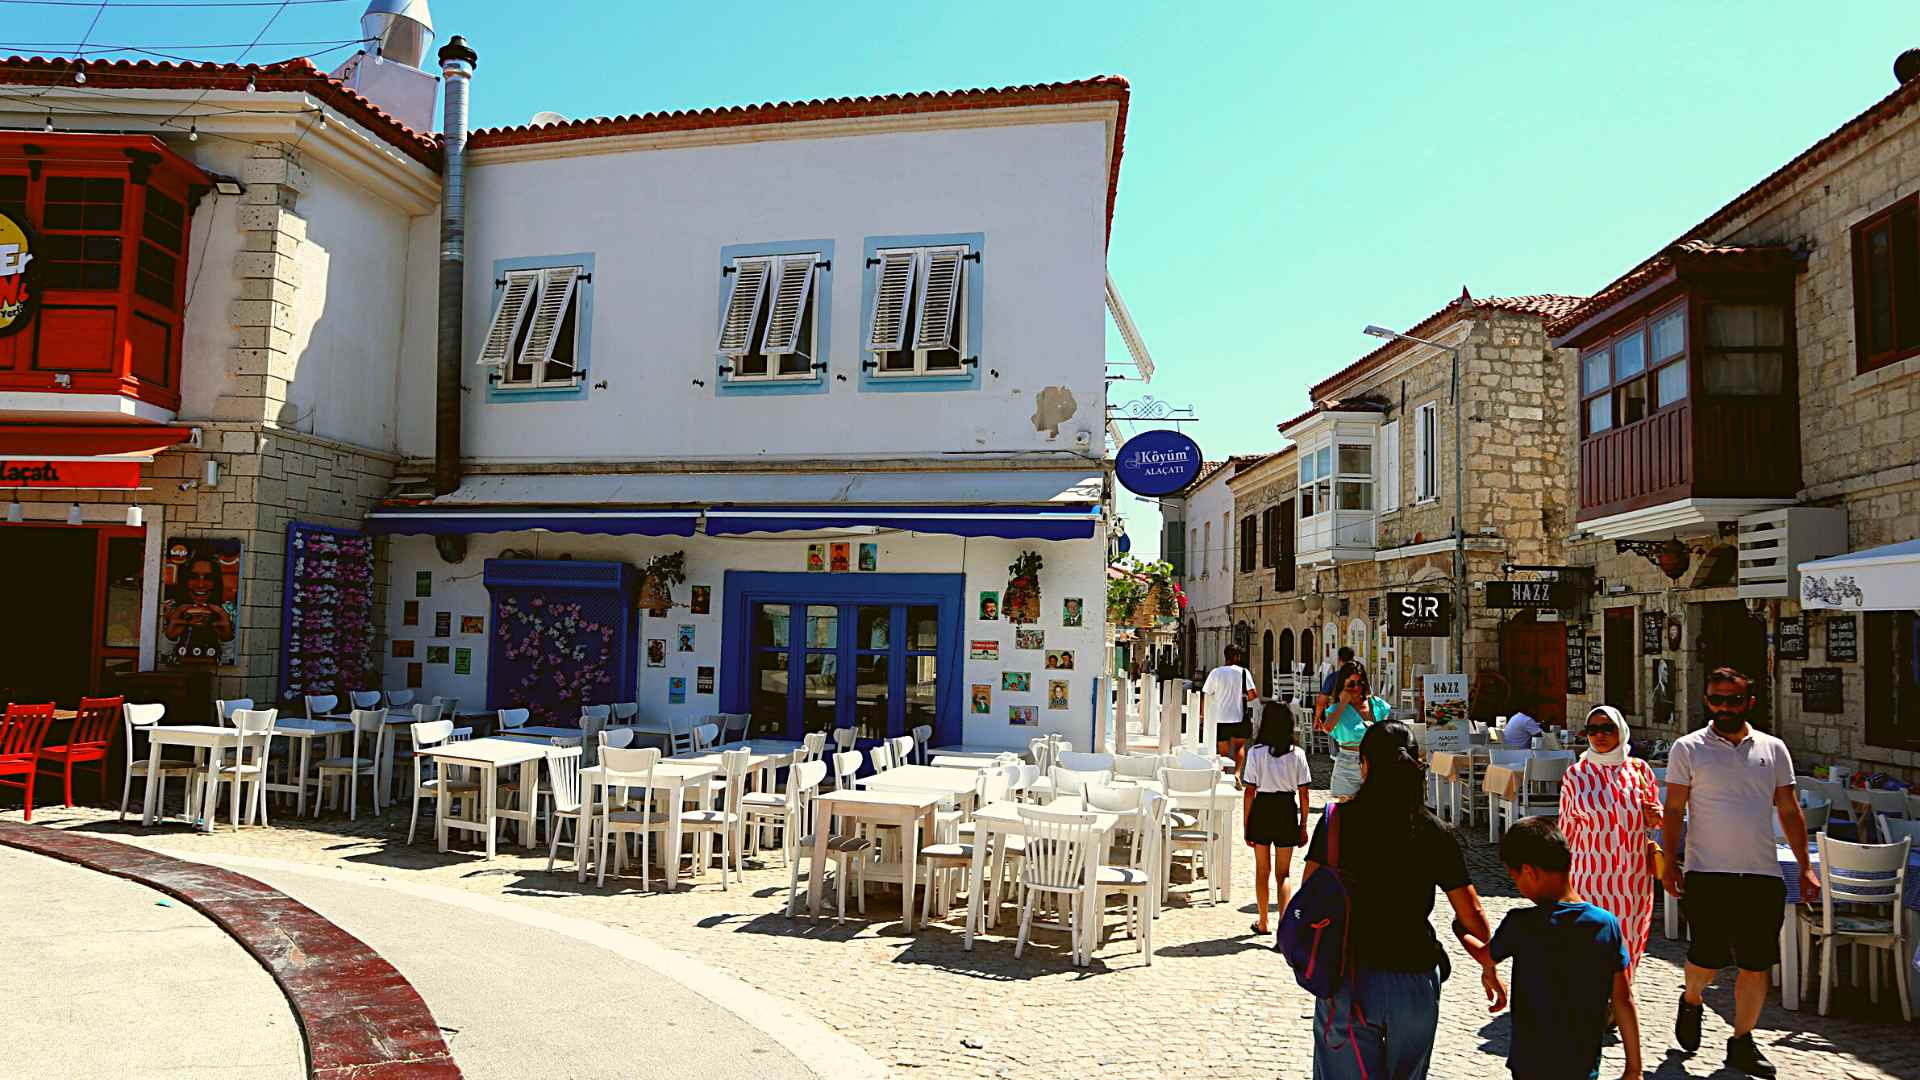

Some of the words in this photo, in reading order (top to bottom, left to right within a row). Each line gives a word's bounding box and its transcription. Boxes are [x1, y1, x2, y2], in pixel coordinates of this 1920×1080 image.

[1141, 450, 1187, 466] Köyüm
[1145, 466, 1184, 476] ALAÇATI
[1512, 584, 1550, 601] HAZZ
[1401, 596, 1440, 618] SIR
[1433, 682, 1460, 694] HAZZ
